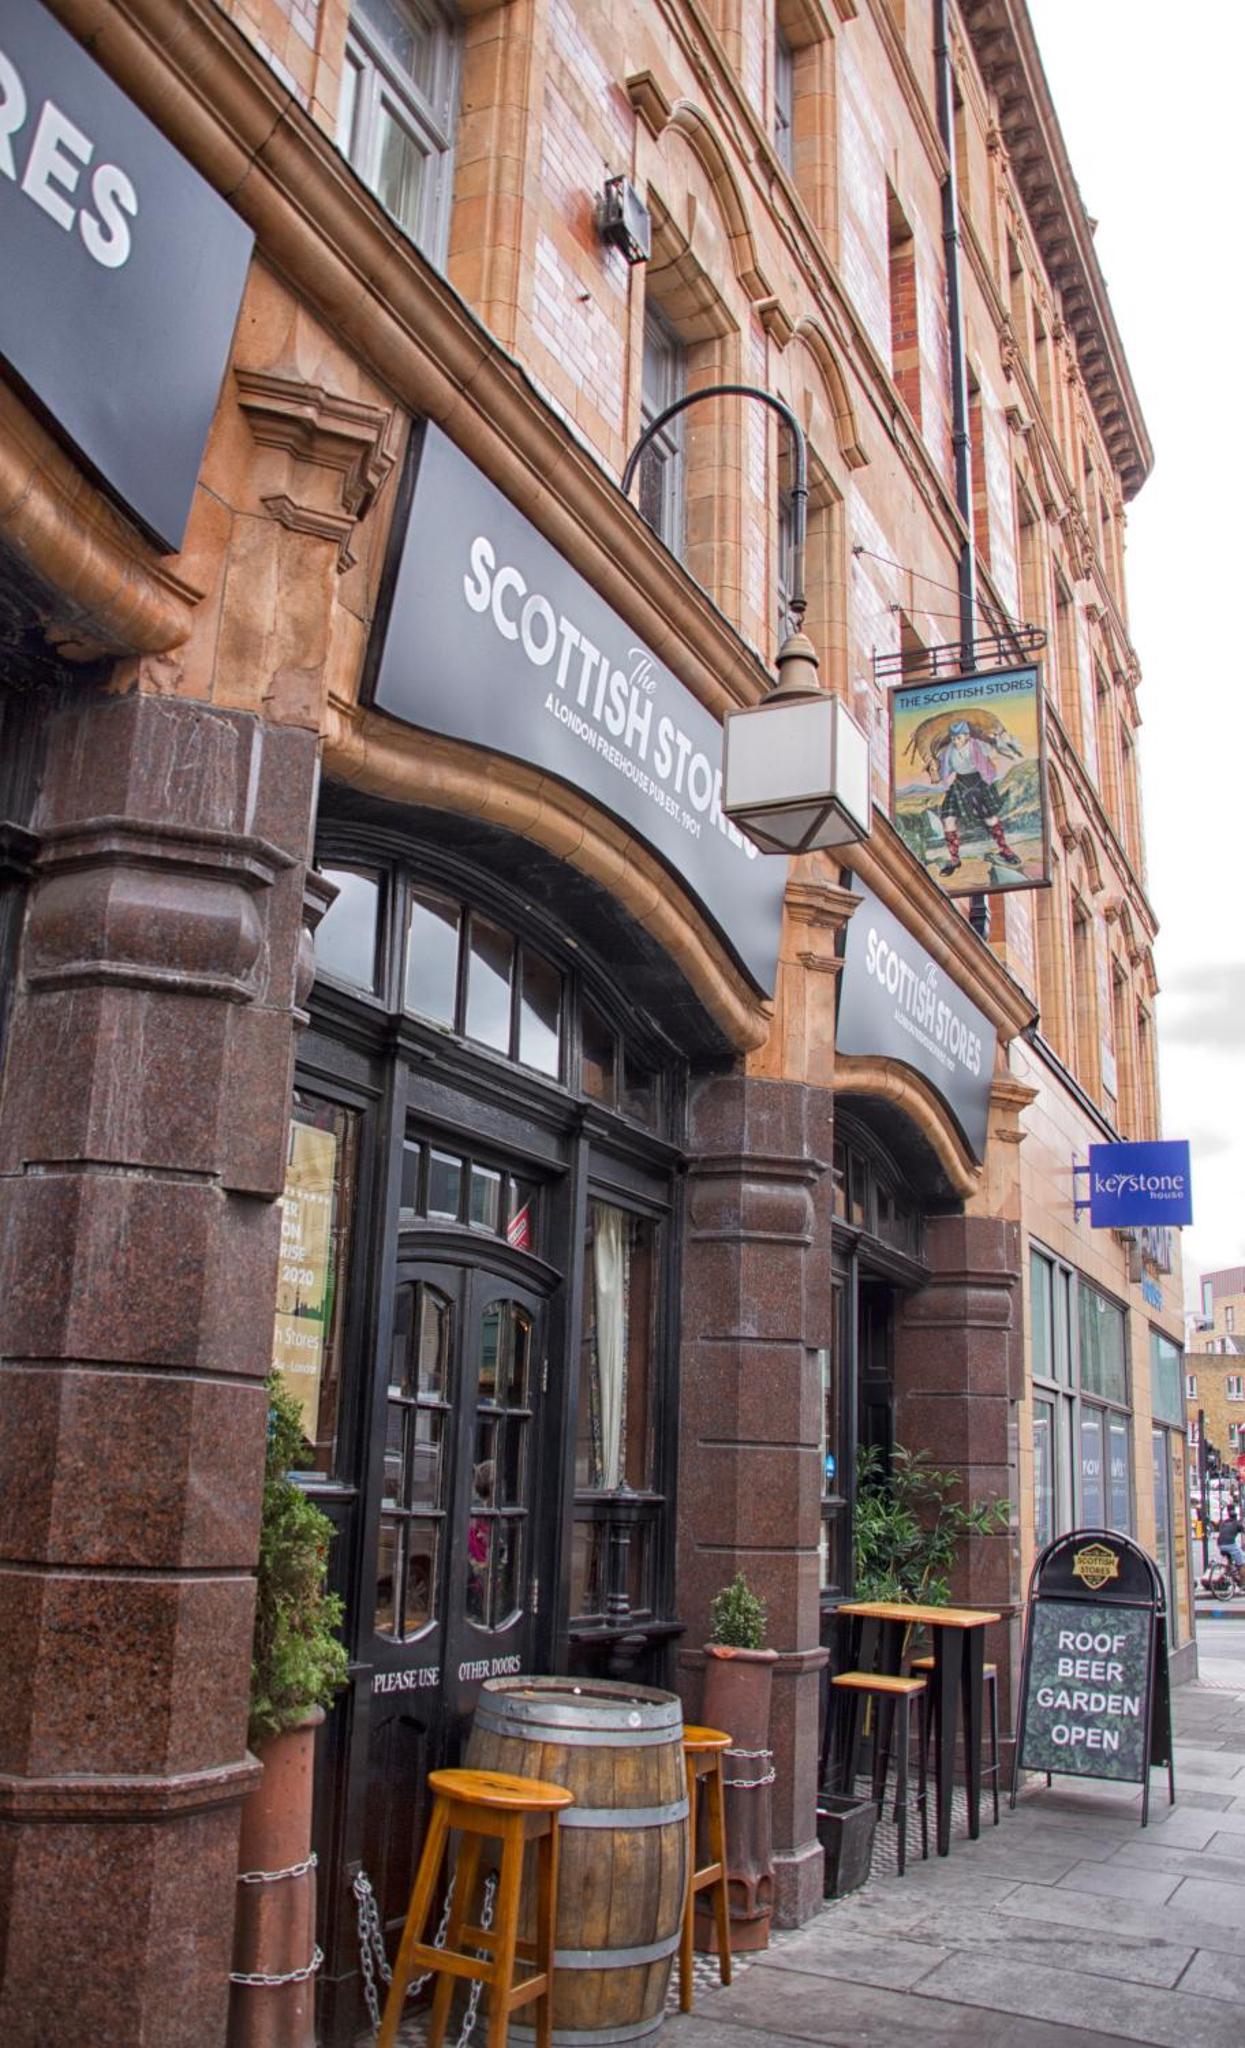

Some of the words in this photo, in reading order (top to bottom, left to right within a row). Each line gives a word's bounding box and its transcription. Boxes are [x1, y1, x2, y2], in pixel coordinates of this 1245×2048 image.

[628, 647, 657, 694] The
[464, 536, 653, 760] SCOTTISH
[654, 716, 759, 860] STOR
[900, 695, 921, 709] THE
[923, 686, 984, 705] SCOTTISH
[986, 679, 1033, 695] STORES
[545, 692, 553, 713] A
[554, 698, 597, 750] LONDON
[597, 735, 649, 794] FREEHOUSE
[665, 794, 681, 822] EST.
[681, 811, 701, 840] 1901
[865, 927, 937, 1034] SCOTTISH
[935, 1000, 982, 1077] STORES
[1095, 1173, 1185, 1199] keystone
[1150, 1190, 1185, 1200] house
[282, 1265, 315, 1287] 2020
[283, 1327, 319, 1350] Stores
[1077, 1556, 1115, 1567] SCOTTISH
[1080, 1566, 1110, 1575] STORES
[1058, 1631, 1126, 1655] ROOF
[374, 1669, 417, 1694] PLEASE
[419, 1667, 440, 1687] USE
[458, 1660, 489, 1682] OTHER
[491, 1655, 521, 1676] DOORS
[1057, 1658, 1123, 1682] BEER
[1037, 1687, 1140, 1716] GARDEN
[1051, 1725, 1119, 1750] OPEN
